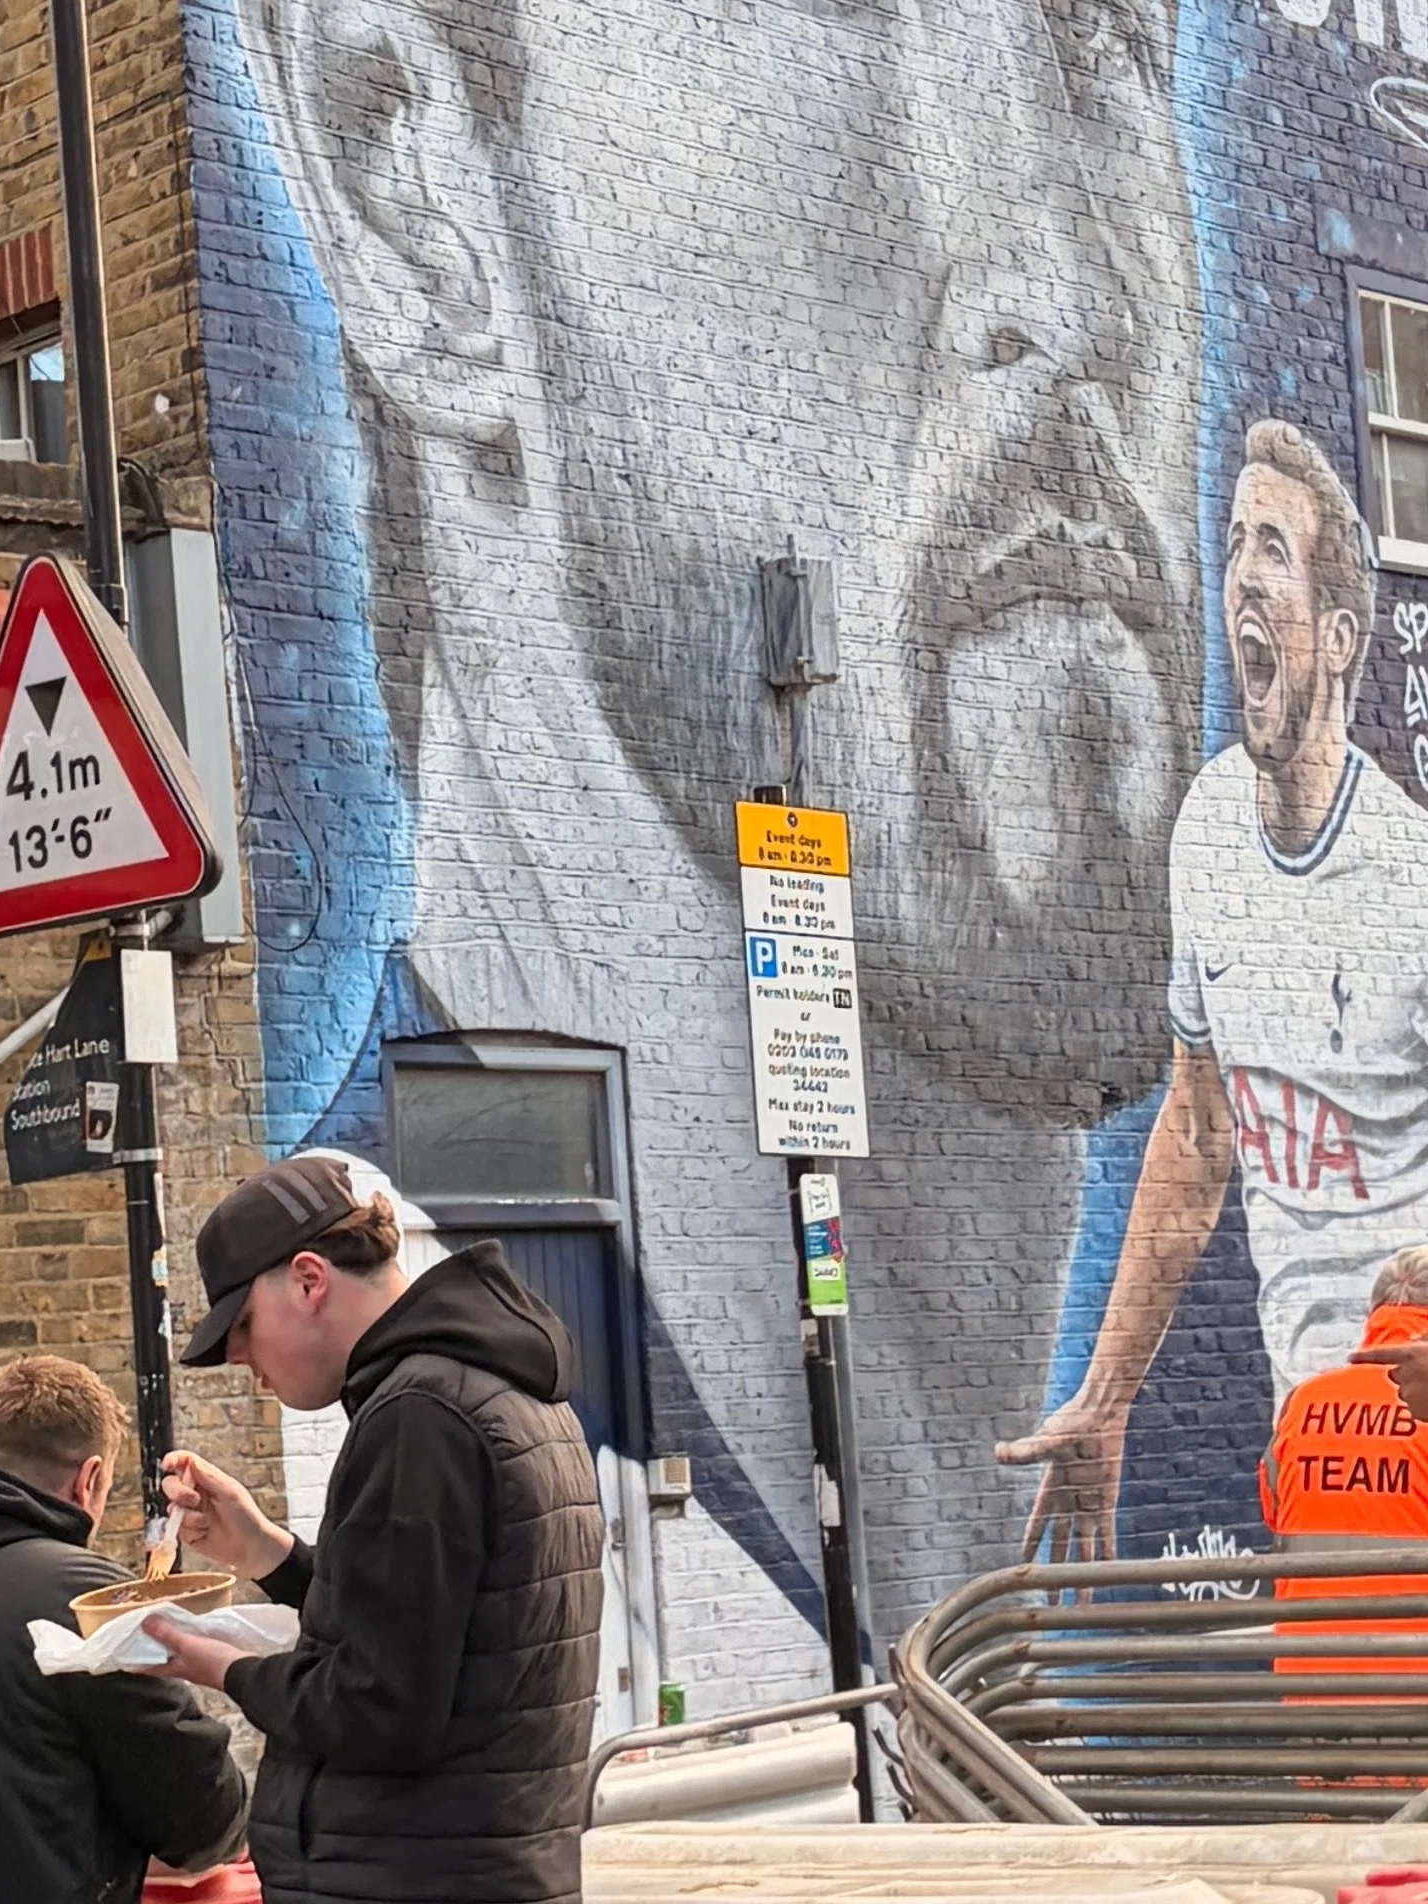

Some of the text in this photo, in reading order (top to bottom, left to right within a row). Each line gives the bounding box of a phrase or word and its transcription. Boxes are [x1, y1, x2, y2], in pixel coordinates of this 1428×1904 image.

[6, 751, 100, 800] 4.1m
[755, 941, 773, 974] P
[74, 1038, 110, 1058] Lane
[11, 1097, 80, 1130] Southbound
[1233, 1067, 1369, 1200] AIA
[1298, 1456, 1409, 1494] TEAM
